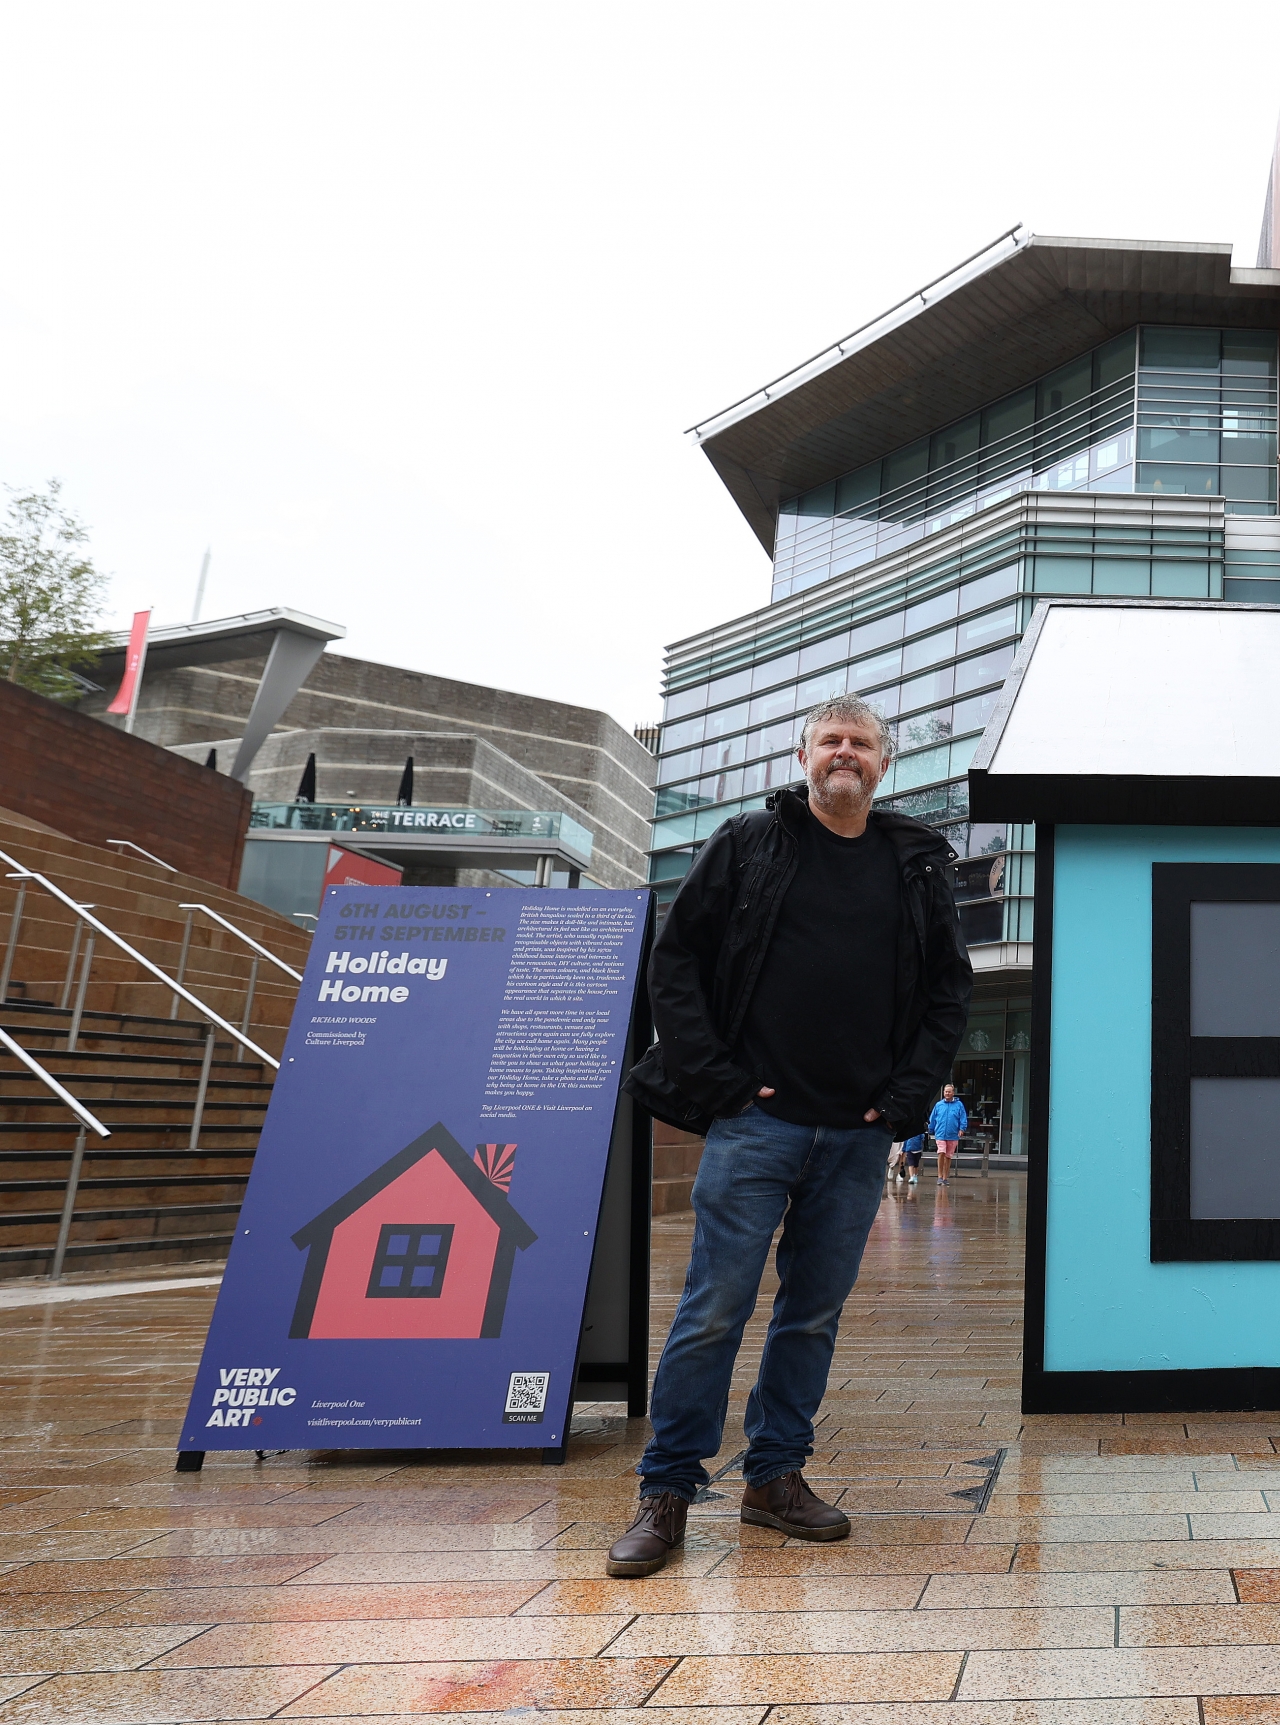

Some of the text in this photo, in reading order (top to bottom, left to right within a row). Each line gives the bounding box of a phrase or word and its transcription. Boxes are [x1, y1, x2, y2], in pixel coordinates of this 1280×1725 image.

[370, 810, 476, 828] THE TERRACE
[339, 903, 472, 920] 6TH AUGUST
[334, 925, 506, 942] 5TH SEPTEMBER
[325, 950, 448, 980] Holiday
[318, 980, 410, 1003] Home
[219, 1368, 281, 1386] VERY
[212, 1388, 297, 1406] PUBLIC
[311, 1400, 348, 1409] Liverpool
[205, 1408, 256, 1427] ART
[307, 1417, 421, 1427] visitliverpool.com/verypublicart
